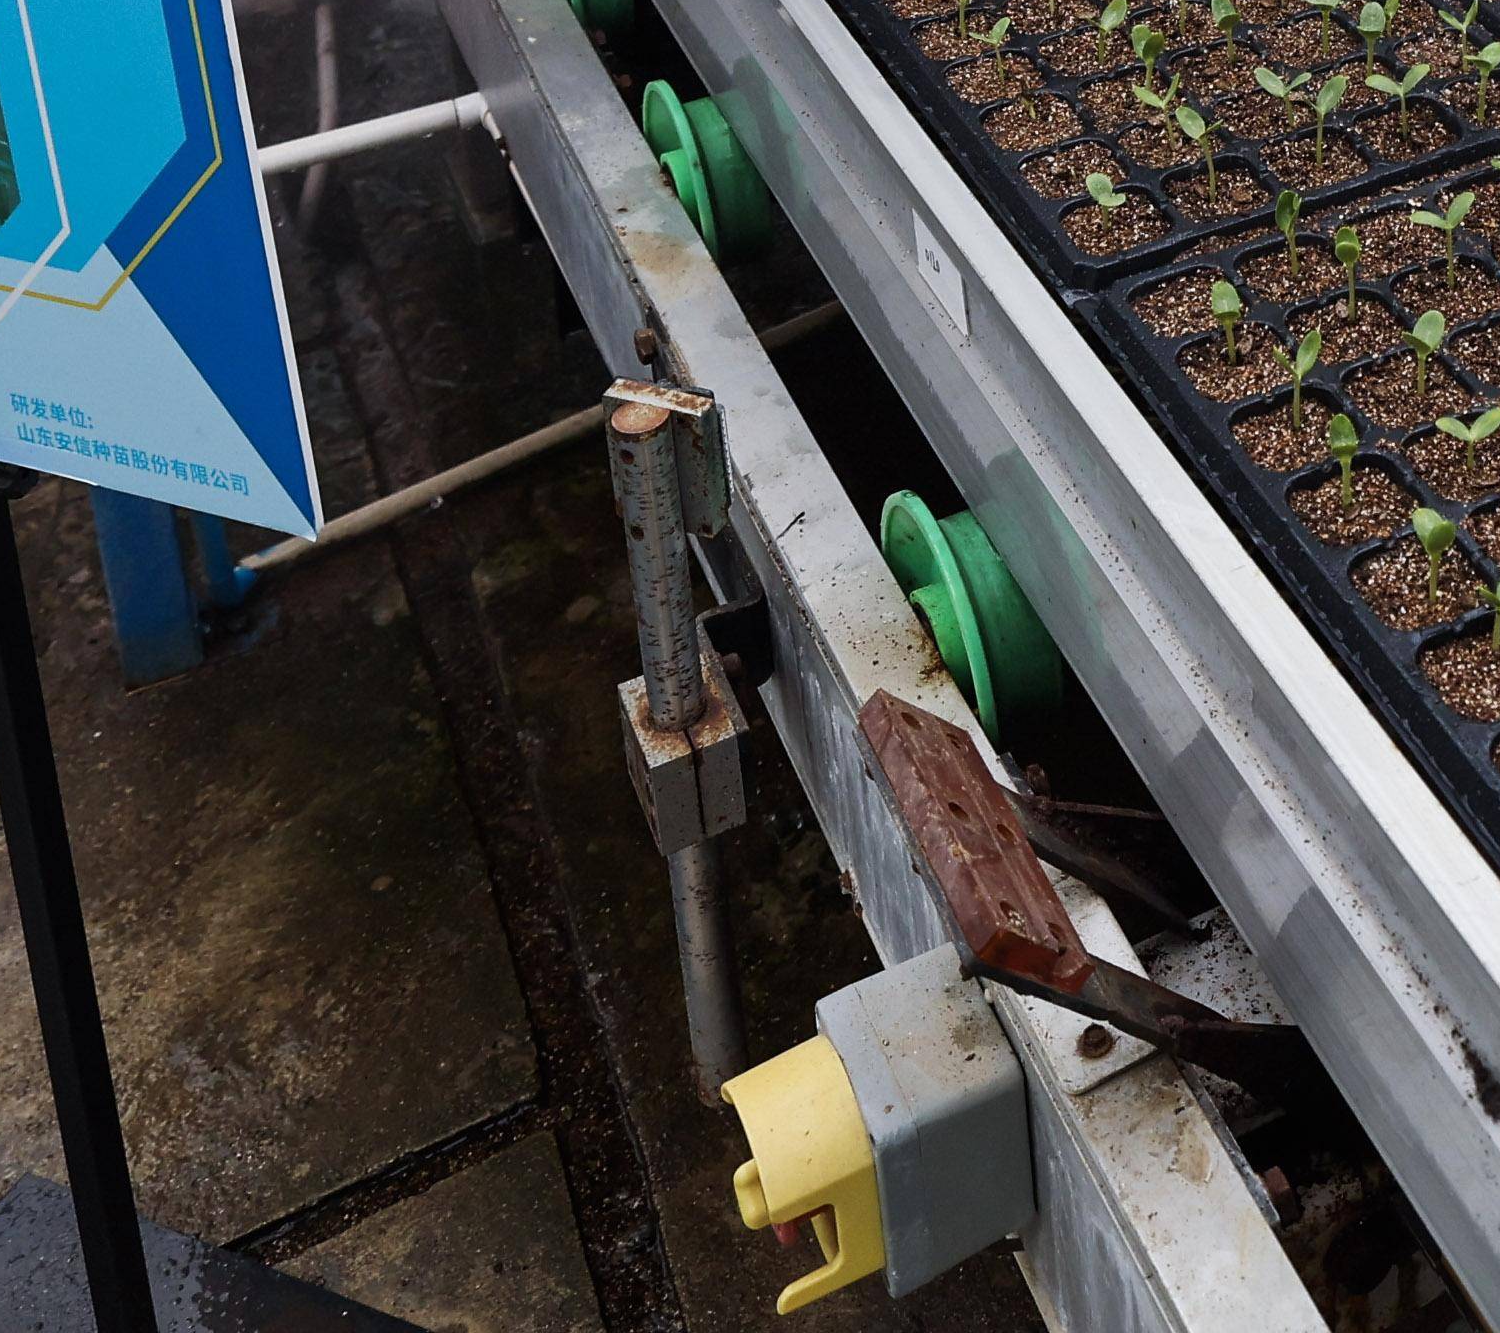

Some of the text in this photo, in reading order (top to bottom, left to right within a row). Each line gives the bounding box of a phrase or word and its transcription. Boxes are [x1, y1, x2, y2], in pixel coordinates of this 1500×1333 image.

[10, 393, 93, 429] 研发单位：
[16, 422, 250, 496] 山东安信种苗股份有限公司
